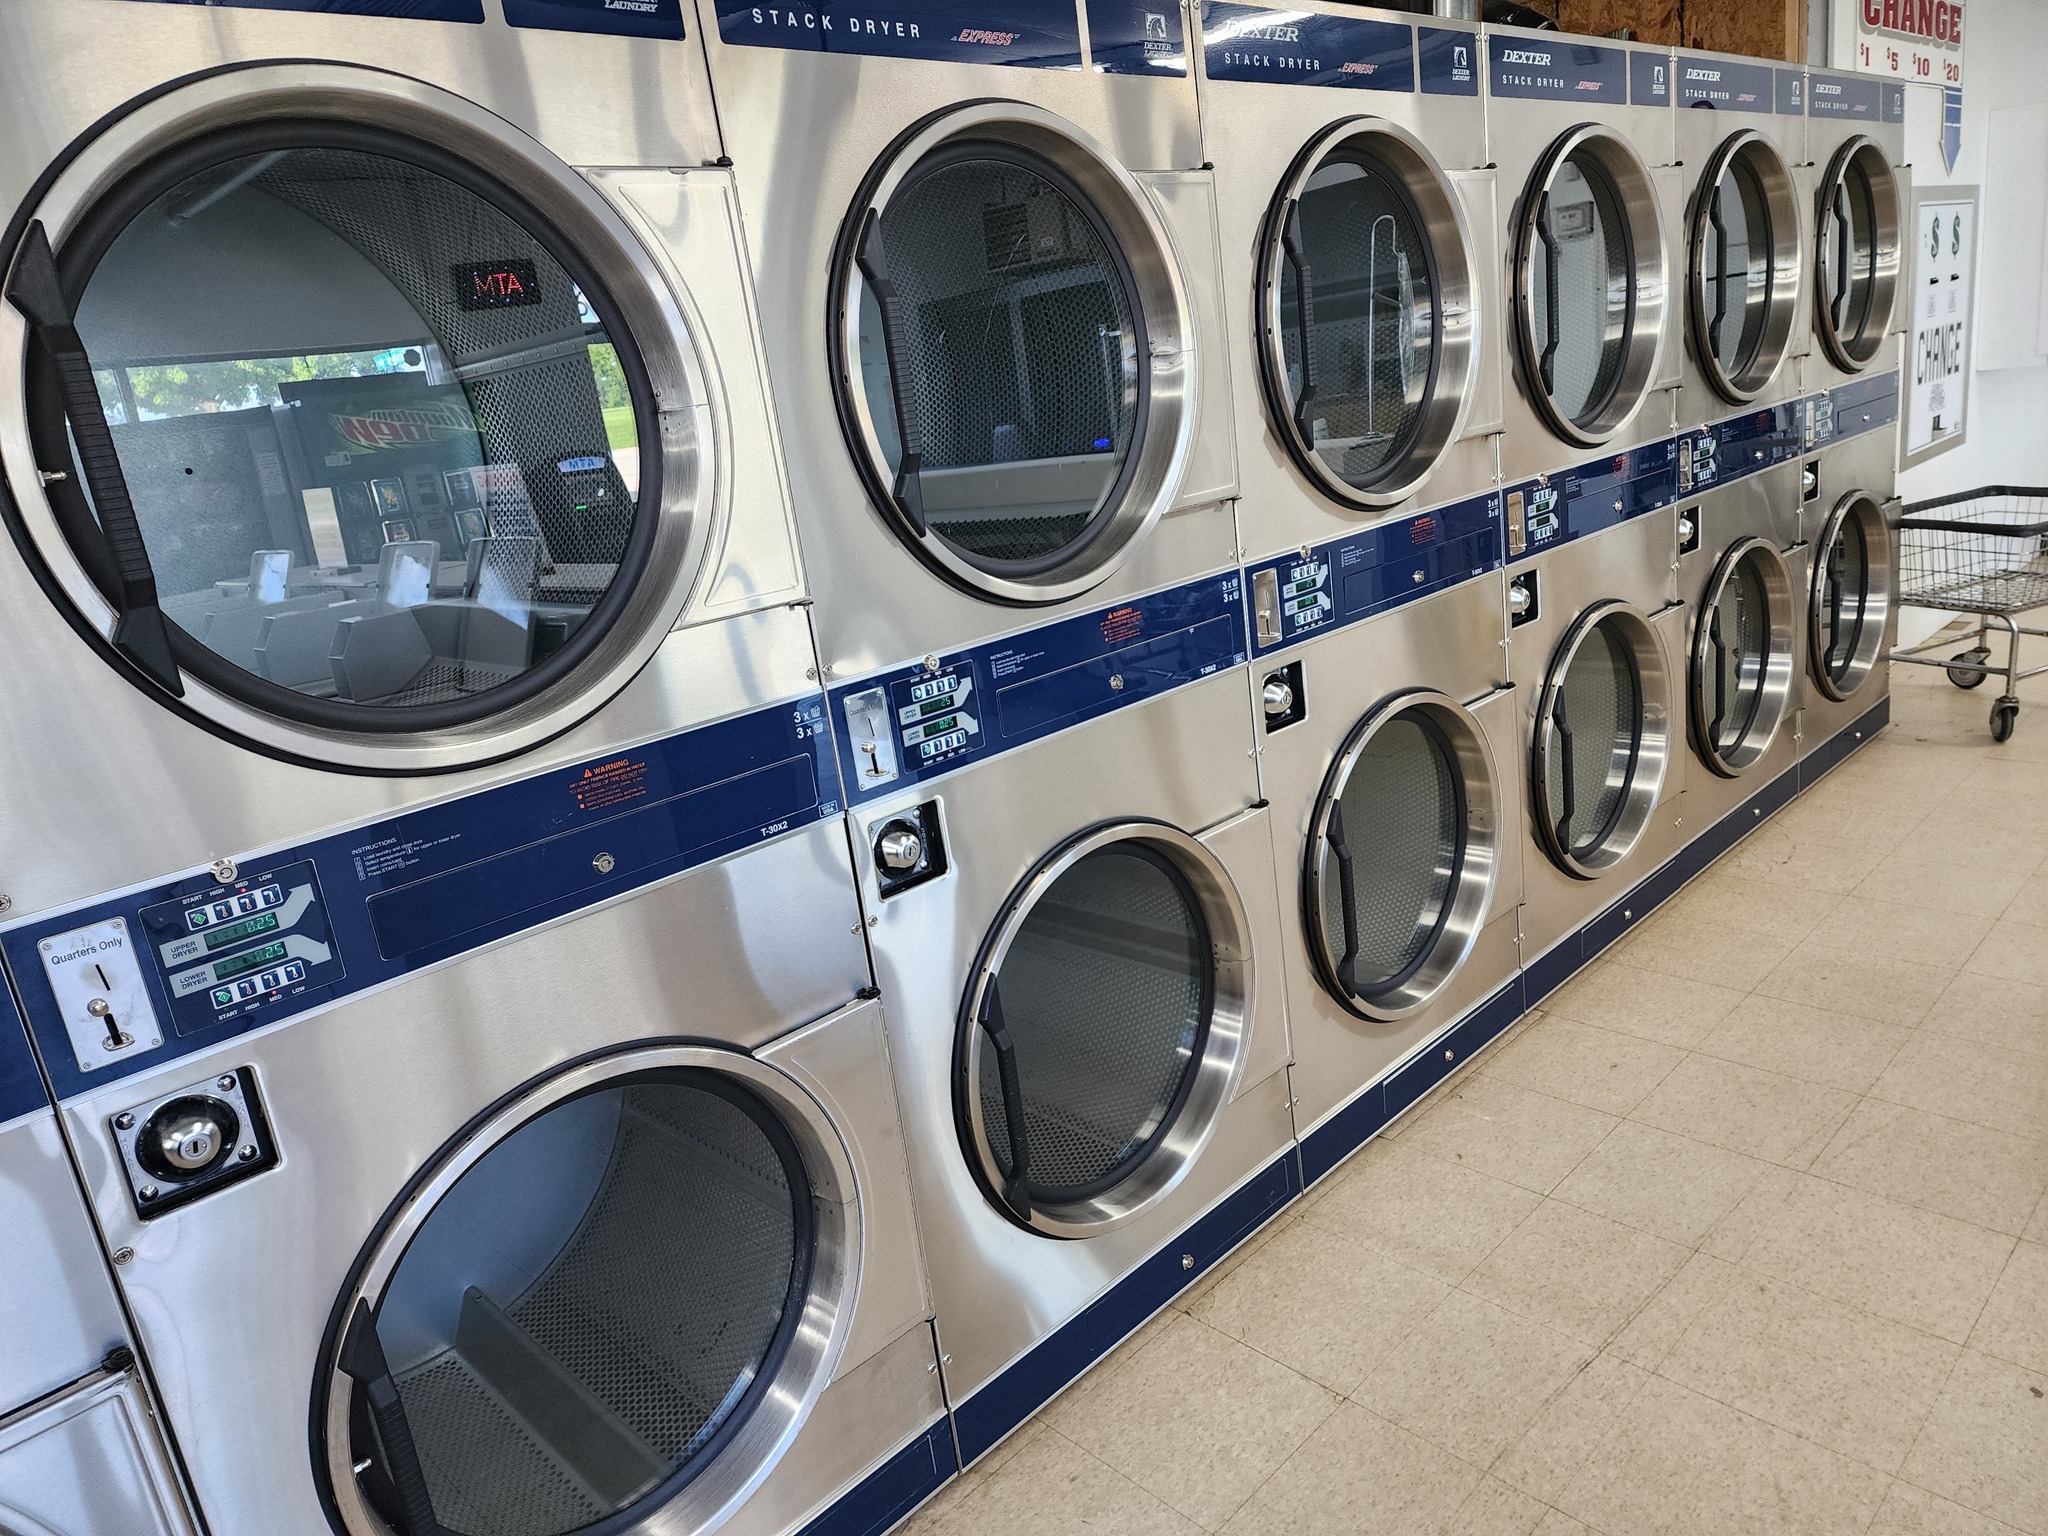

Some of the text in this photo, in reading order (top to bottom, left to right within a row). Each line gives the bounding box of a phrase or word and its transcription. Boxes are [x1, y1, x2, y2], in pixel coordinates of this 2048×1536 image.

[604, 0, 658, 13] LAUNDRY
[752, 7, 920, 38] STACK DRYER
[1864, 0, 1962, 45] CHANGE
[958, 28, 1015, 46] EXPRESS
[1225, 20, 1299, 42] DEXTER
[1225, 52, 1320, 71] STACK DRYER
[1502, 50, 1551, 66] DEXTER
[1860, 42, 1959, 82] $1 $5 $10 $20
[1342, 62, 1375, 75] EXPRESS
[1502, 74, 1564, 88] STACK DRYER
[1686, 69, 1721, 82] DEXTER
[1685, 89, 1707, 98] STACK
[1710, 92, 1730, 100] DRYER
[1815, 84, 1842, 95] DEXTER
[1917, 322, 1962, 386] CHANGE
[1222, 581, 1227, 590] 3
[1223, 593, 1228, 603] 3
[793, 711, 810, 723] 3 x
[796, 727, 813, 739] 3 x
[593, 759, 629, 775] WARNING
[760, 821, 789, 837] T-30X2
[351, 837, 397, 855] INSTRUCTIONS
[381, 864, 398, 873] START
[258, 873, 273, 881] LOW
[234, 881, 249, 889] MED
[209, 888, 225, 897] HIGH
[182, 895, 203, 905] START
[51, 937, 122, 965] Quarters Only
[170, 941, 197, 953] UPPER
[172, 947, 199, 960] DRYER
[180, 971, 207, 984] LOWER
[181, 977, 208, 990] DRYER
[218, 985, 306, 1021] START HIGH MED LOW
